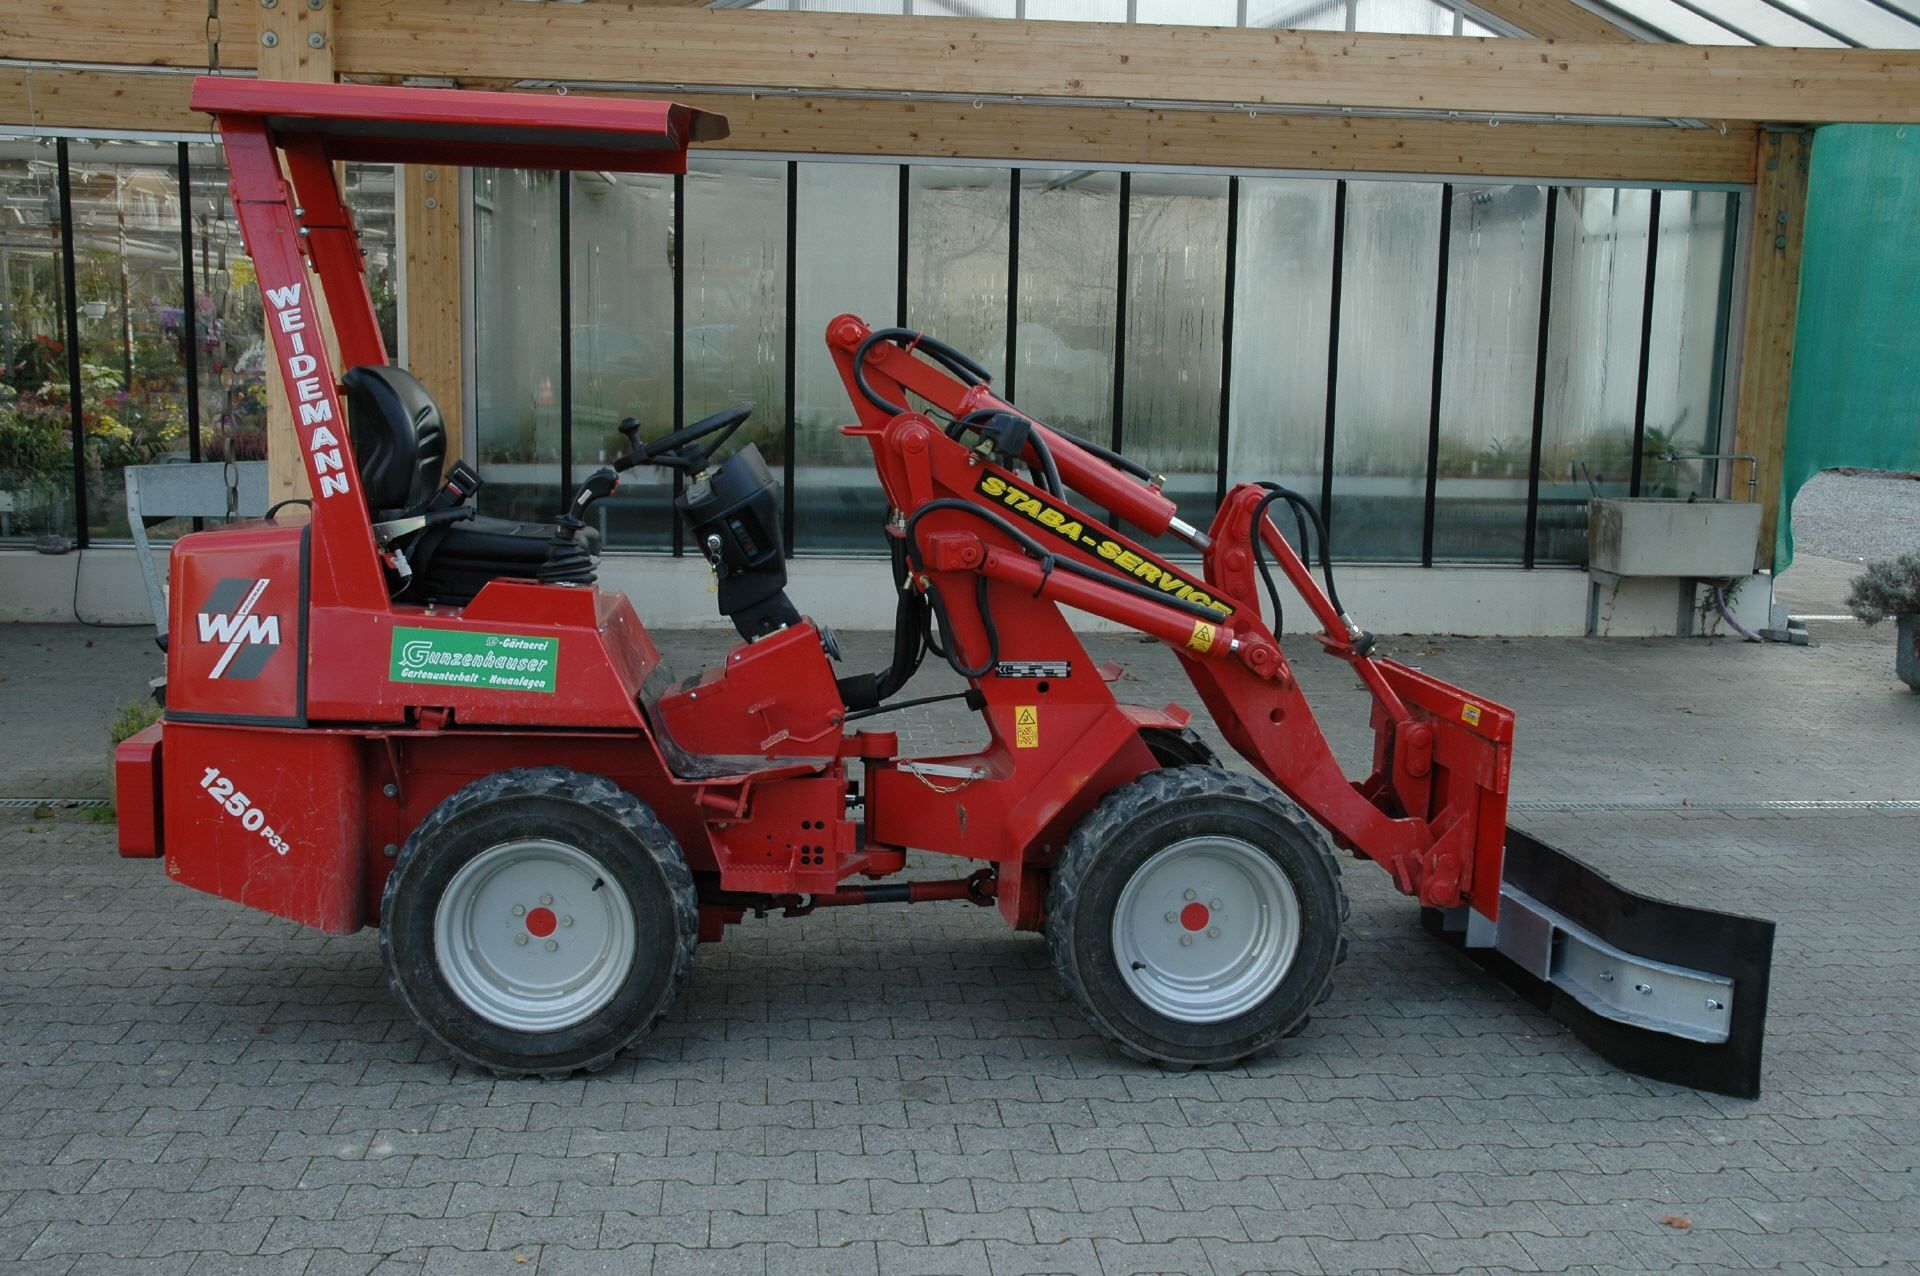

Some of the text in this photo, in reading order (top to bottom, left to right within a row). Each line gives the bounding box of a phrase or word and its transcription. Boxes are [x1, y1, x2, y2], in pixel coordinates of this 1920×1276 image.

[266, 283, 349, 498] WEIDEMANN
[398, 640, 548, 672] Gunzenhauser
[401, 667, 479, 683] Gartenunterhalt
[489, 674, 546, 689] Neuanlagen
[199, 766, 265, 831] 1250
